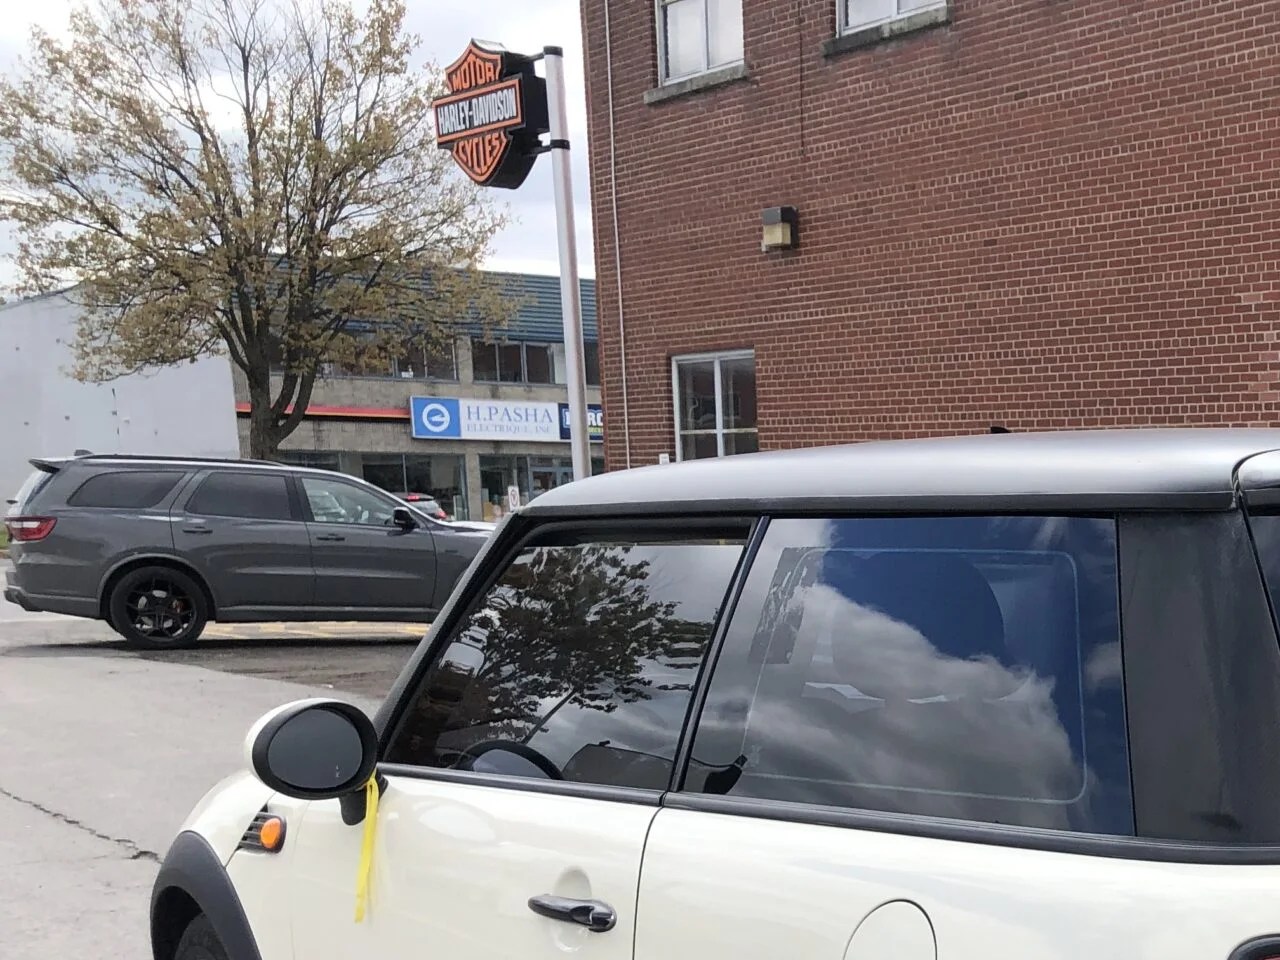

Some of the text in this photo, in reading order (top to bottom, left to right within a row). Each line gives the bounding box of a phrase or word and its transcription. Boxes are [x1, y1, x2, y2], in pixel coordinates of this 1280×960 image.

[453, 55, 494, 91] MOTOR
[437, 88, 516, 135] HARLEY-DAVIDSON
[458, 132, 500, 174] CYCLES
[466, 405, 553, 423] H.PASHA
